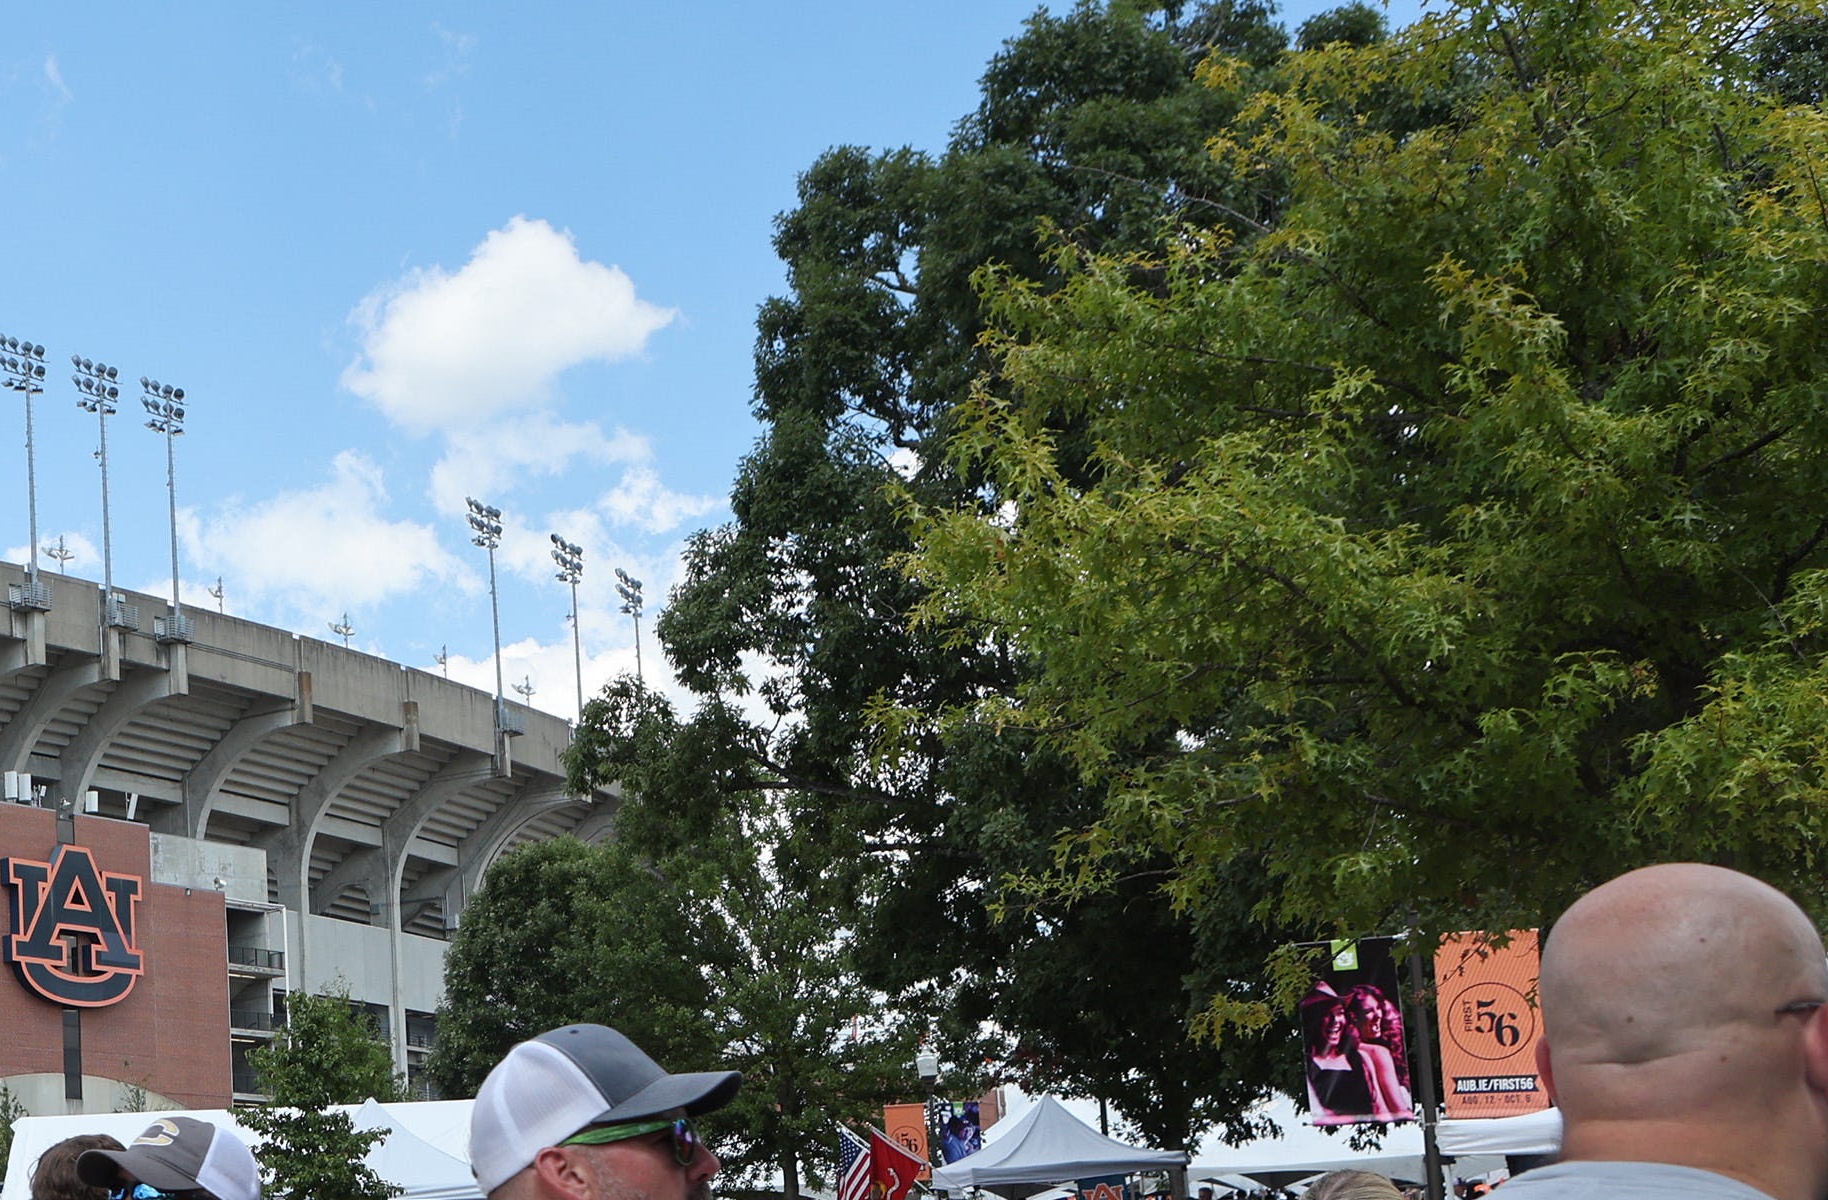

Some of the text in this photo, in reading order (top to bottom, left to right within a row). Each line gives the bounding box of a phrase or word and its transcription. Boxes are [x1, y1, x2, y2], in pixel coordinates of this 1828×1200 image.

[1462, 999, 1520, 1047] FIRST 56
[1456, 1077, 1534, 1093] AUB.IE/FIRST56
